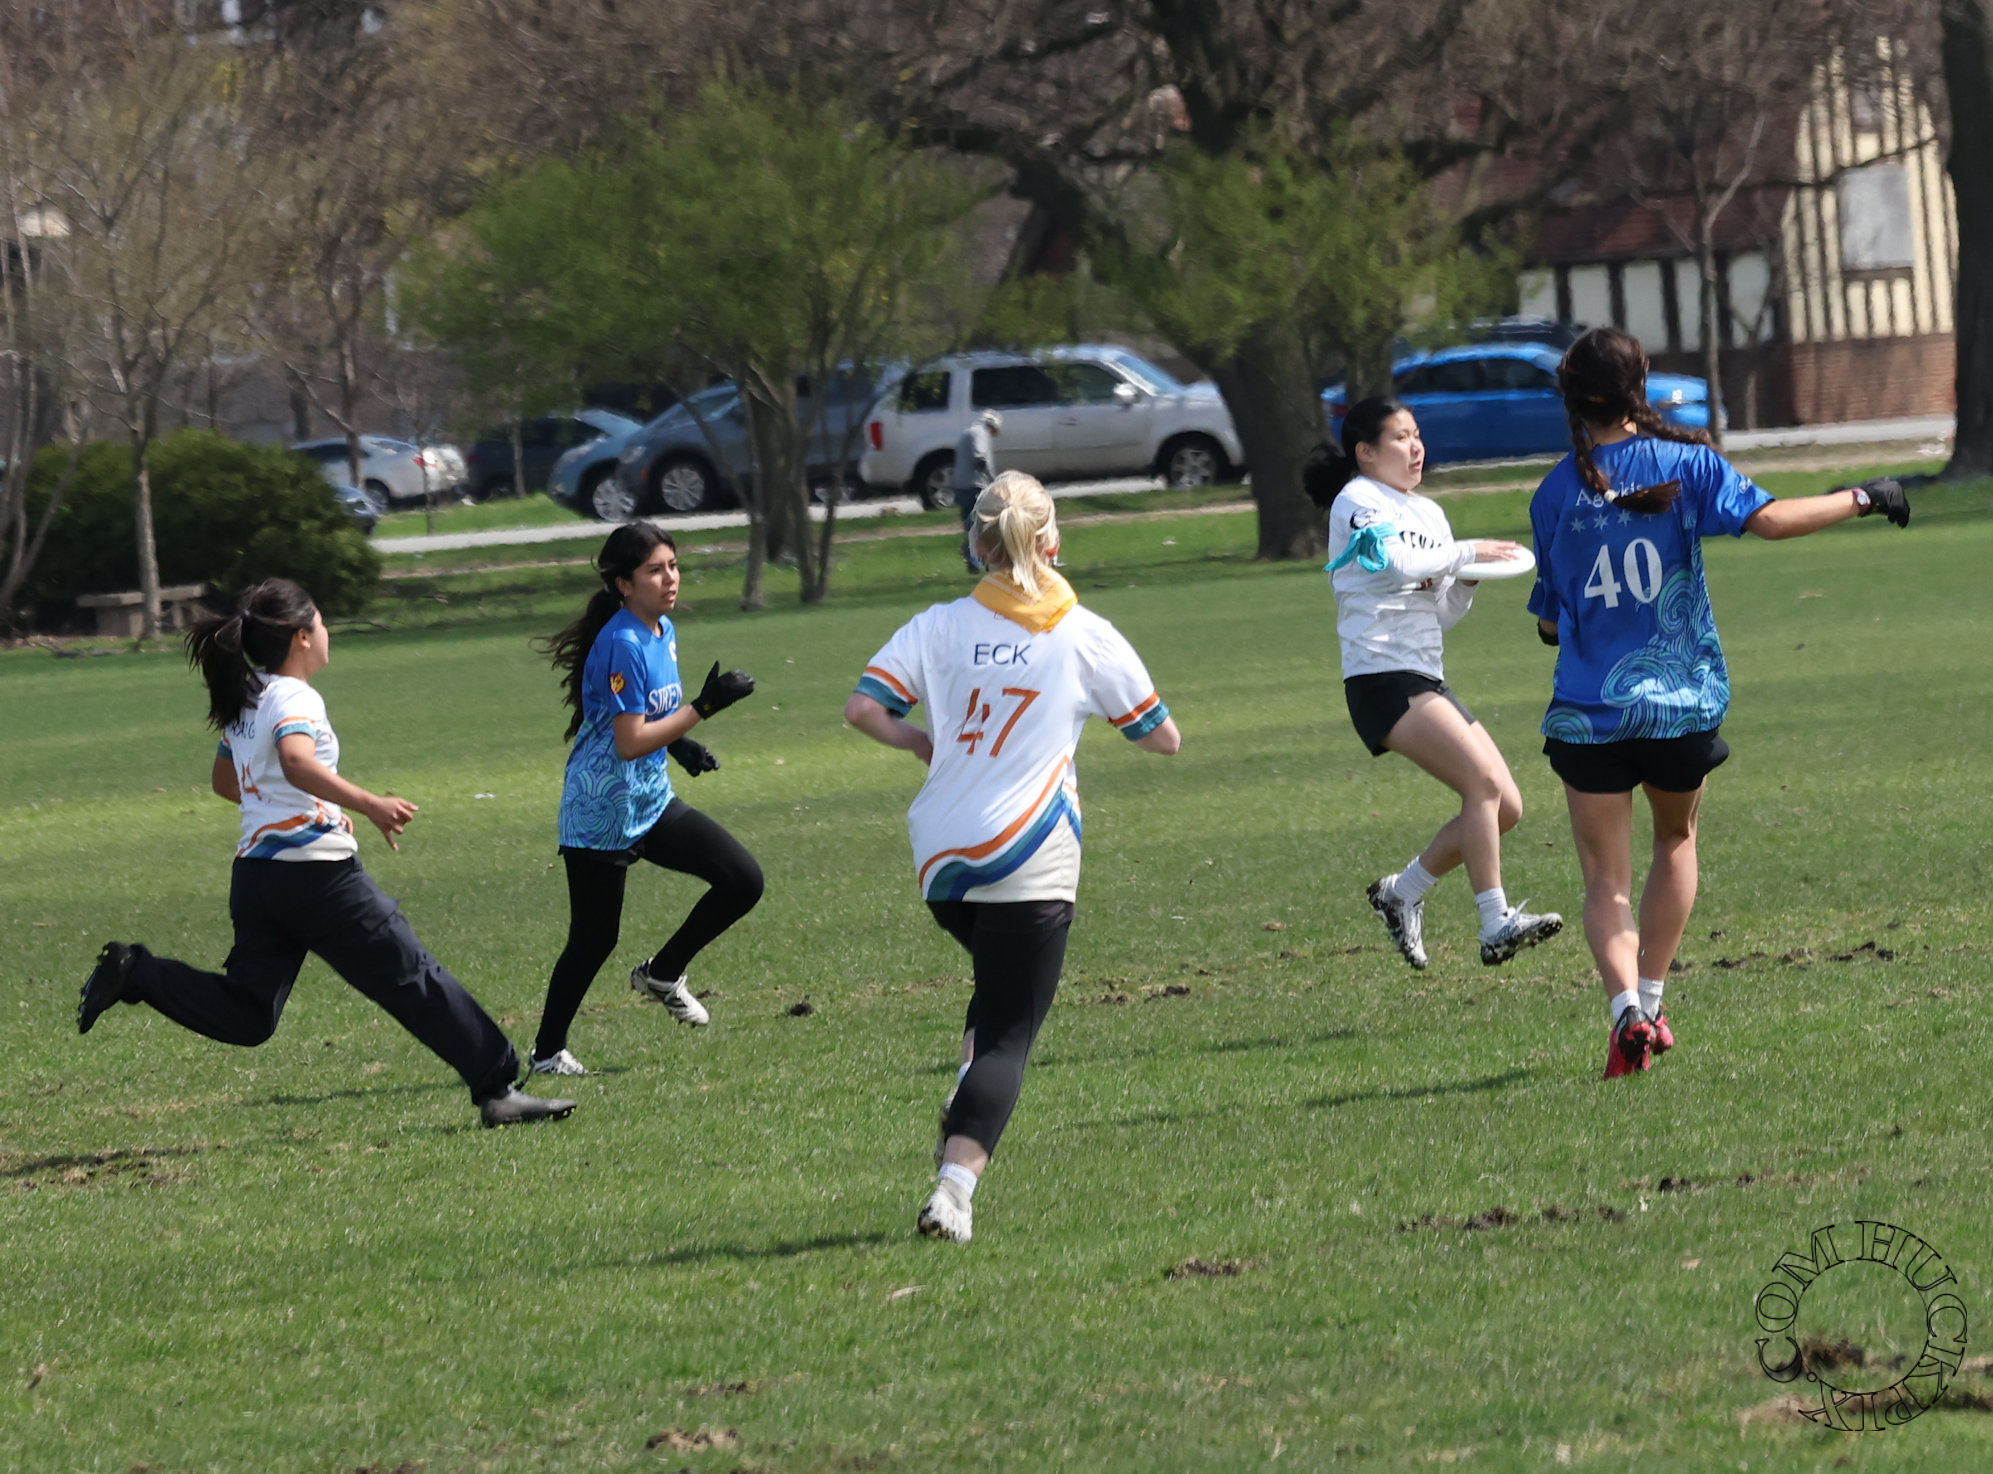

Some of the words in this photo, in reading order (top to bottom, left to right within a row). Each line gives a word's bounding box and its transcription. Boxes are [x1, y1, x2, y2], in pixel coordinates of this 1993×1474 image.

[1584, 538, 1663, 609] 40
[973, 643, 1031, 666] ECK
[956, 687, 1041, 758] 47
